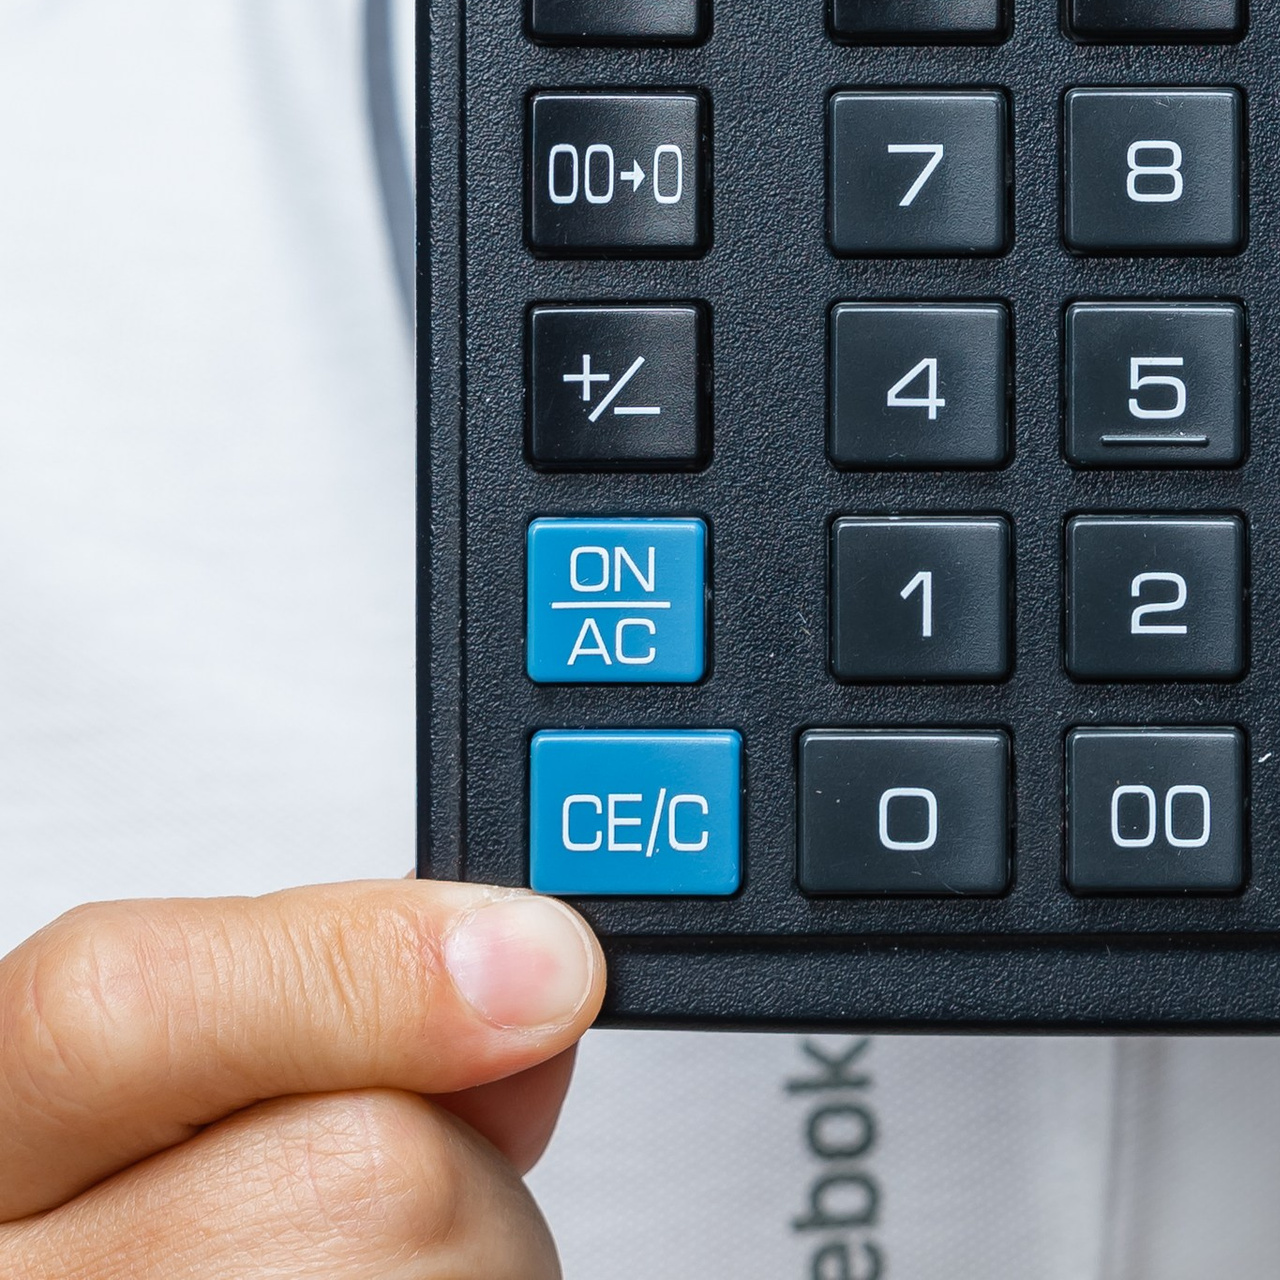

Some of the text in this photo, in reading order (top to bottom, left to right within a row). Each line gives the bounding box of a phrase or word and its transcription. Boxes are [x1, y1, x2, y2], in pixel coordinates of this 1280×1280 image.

[887, 143, 944, 207] 7
[1126, 139, 1184, 203] 8
[886, 357, 946, 420] 4
[1128, 356, 1187, 420] 5
[568, 546, 656, 594] ON
[900, 571, 932, 637] 1
[1130, 571, 1188, 635] 2
[567, 618, 656, 666] AC
[561, 787, 709, 858] CE/C
[878, 787, 938, 851] 0
[1110, 784, 1211, 848] 00
